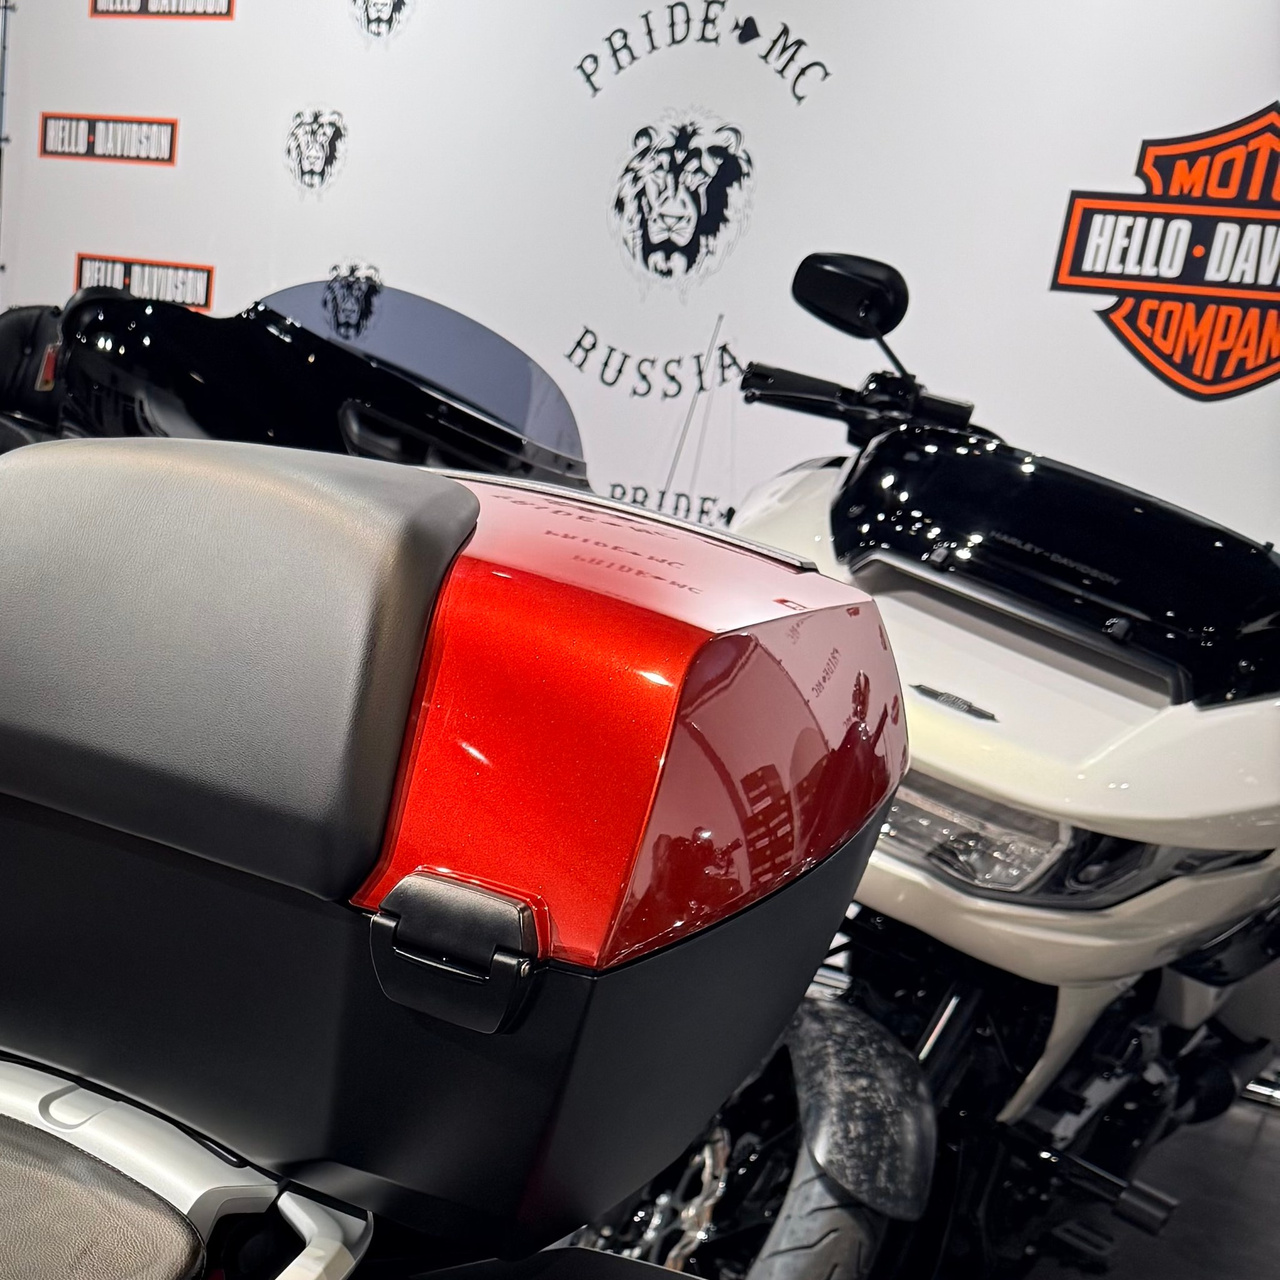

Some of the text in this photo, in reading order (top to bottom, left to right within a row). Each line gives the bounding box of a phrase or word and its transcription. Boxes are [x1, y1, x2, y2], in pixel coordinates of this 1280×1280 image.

[576, 0, 832, 104] PRIDE MC
[1169, 132, 1280, 201] MOT
[1081, 213, 1280, 286] HELLO DAV
[563, 325, 746, 399] RUSSIA
